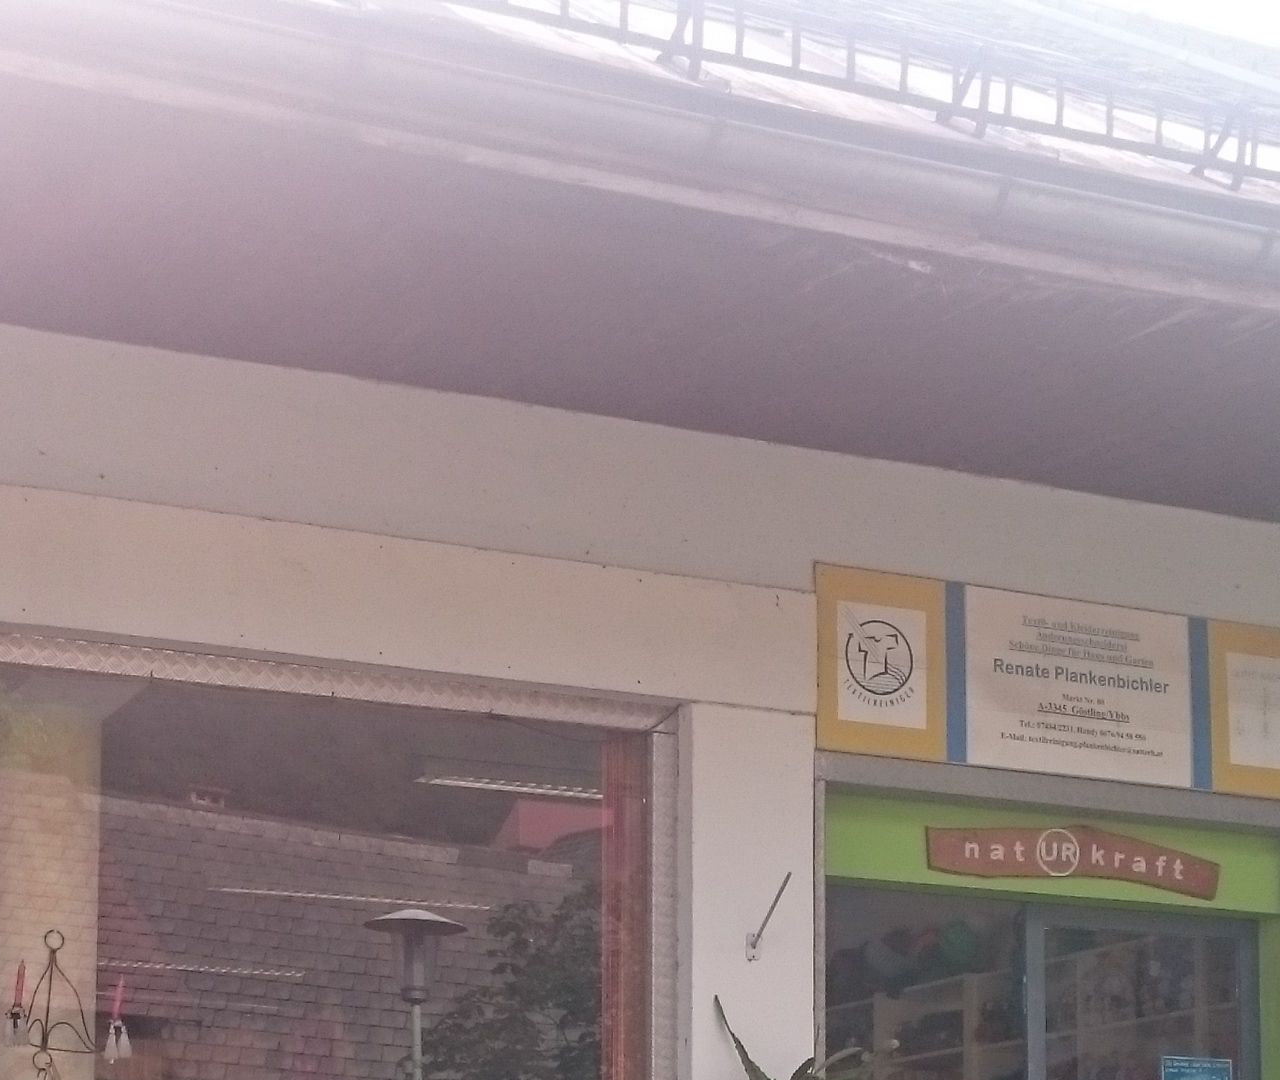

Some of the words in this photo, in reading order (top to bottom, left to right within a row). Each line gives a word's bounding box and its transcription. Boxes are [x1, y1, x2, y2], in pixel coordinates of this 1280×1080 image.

[993, 658, 1051, 680] Renate
[1054, 665, 1170, 695] Plankenbichler
[964, 841, 1025, 862] nat
[1040, 841, 1079, 863] UR
[1091, 843, 1185, 881] kraft
